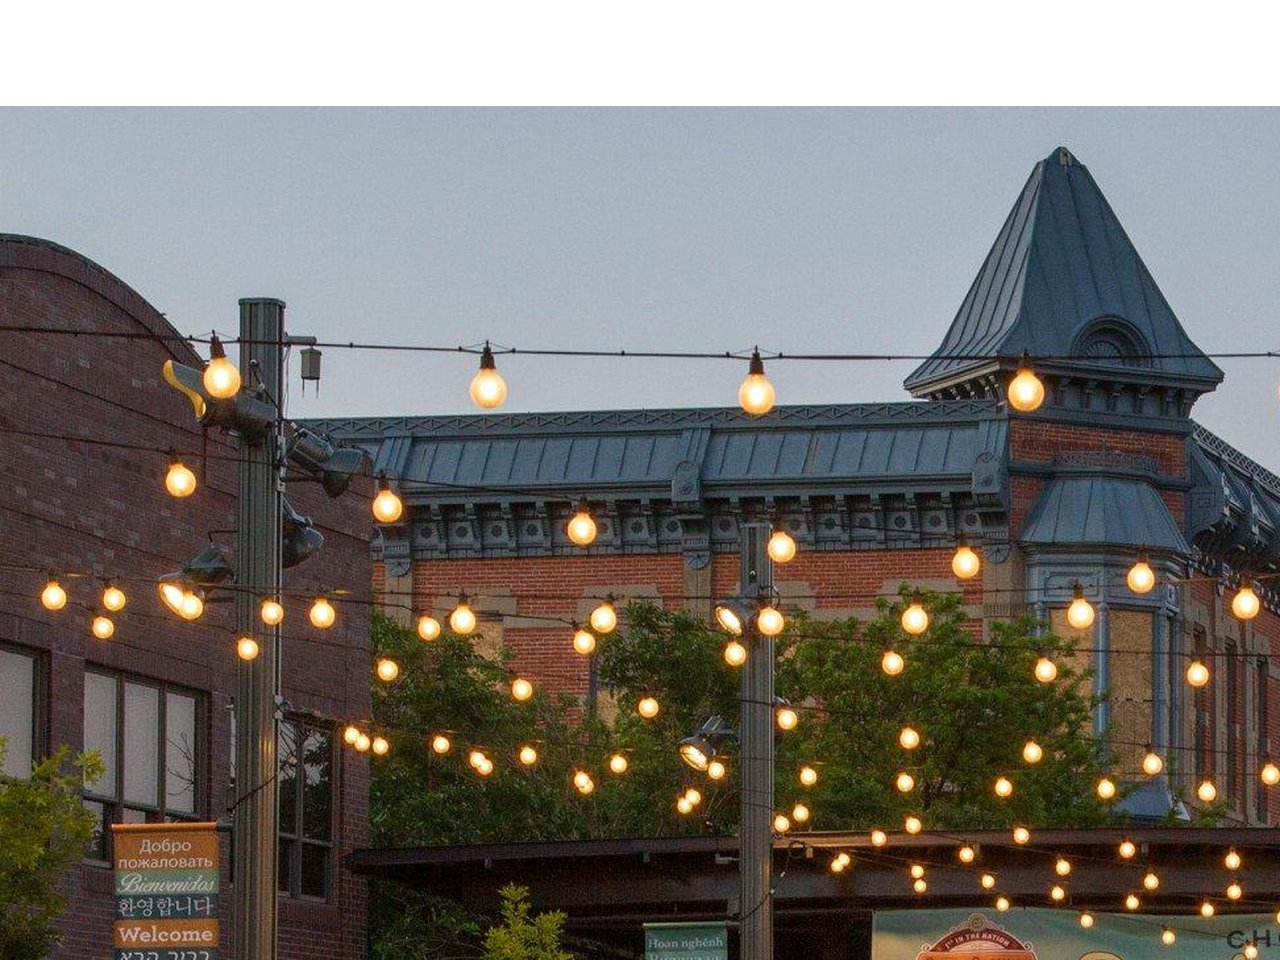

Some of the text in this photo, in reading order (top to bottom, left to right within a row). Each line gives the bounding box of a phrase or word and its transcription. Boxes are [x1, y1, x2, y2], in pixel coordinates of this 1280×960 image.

[139, 839, 192, 856] Добро
[118, 857, 213, 869] пожаловать
[118, 896, 214, 918] 환영합니다
[118, 925, 214, 943] Welcome
